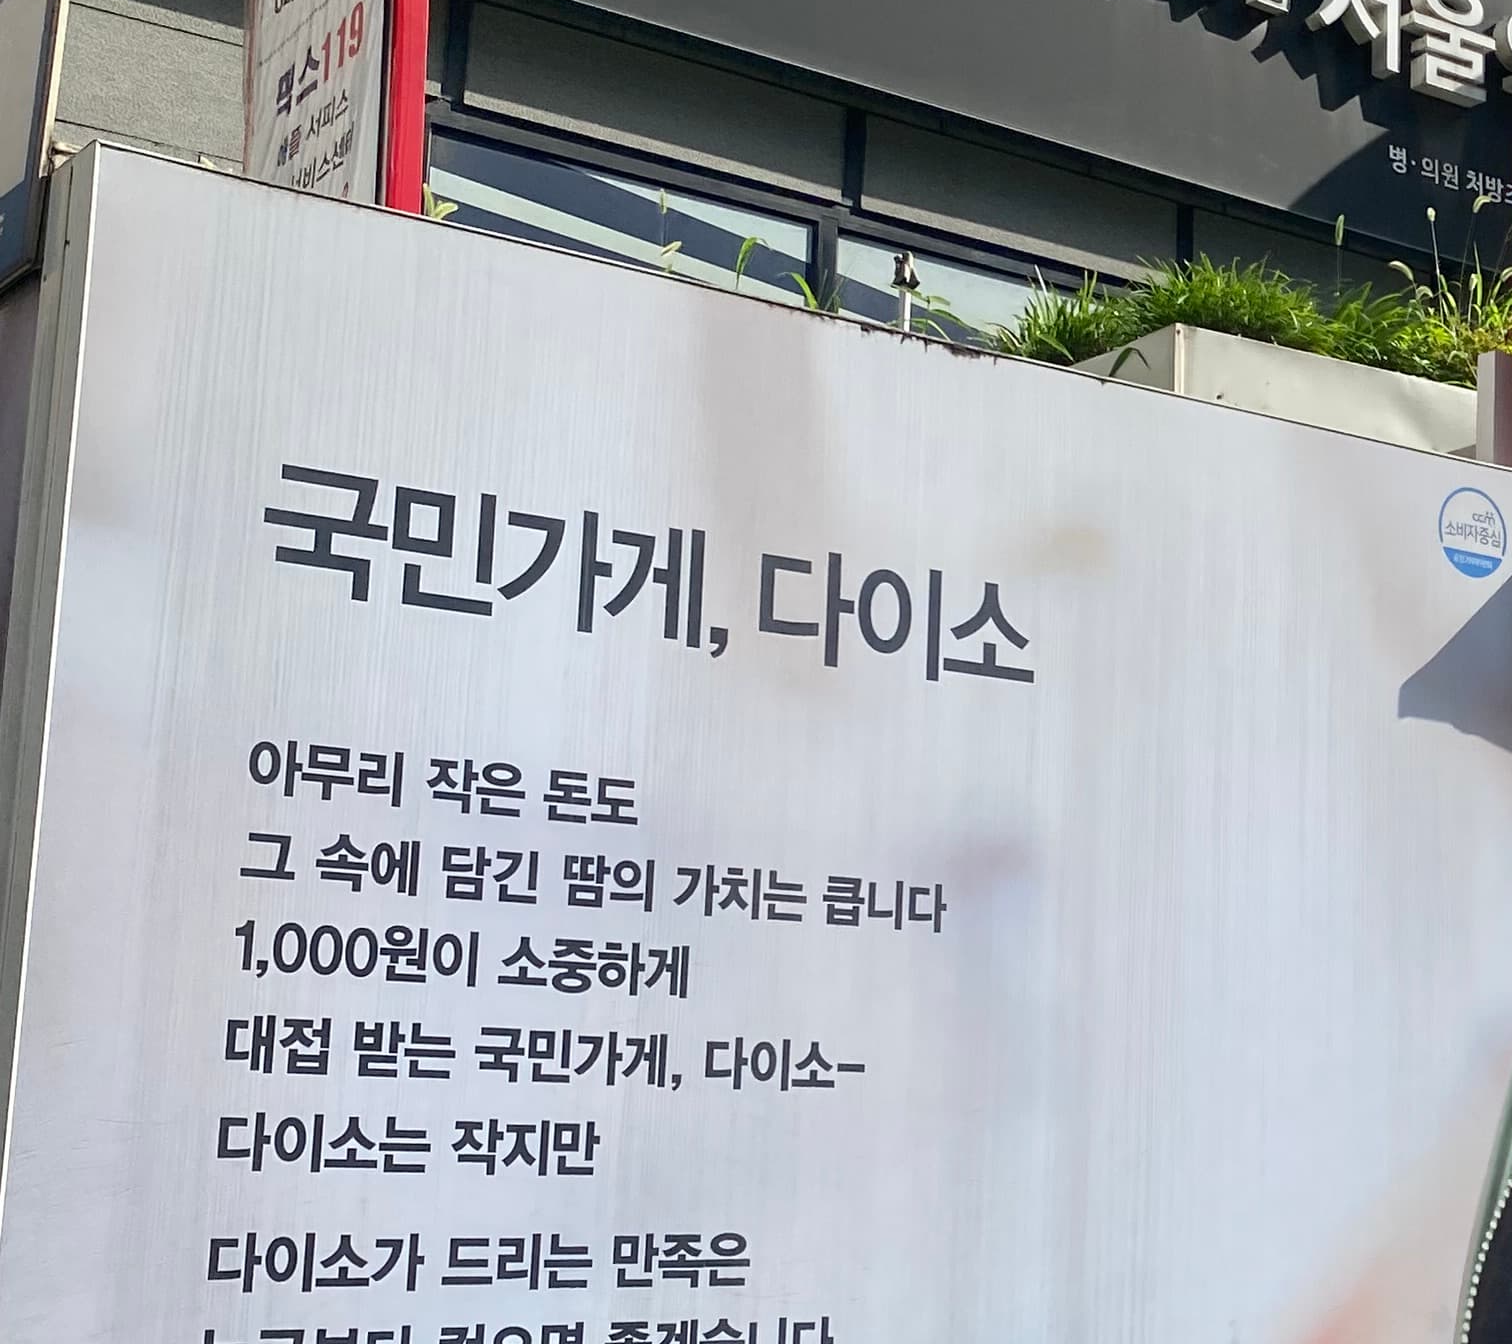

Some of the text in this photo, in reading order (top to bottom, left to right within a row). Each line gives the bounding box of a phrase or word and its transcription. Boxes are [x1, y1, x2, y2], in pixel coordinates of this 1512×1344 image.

[263, 463, 1036, 685] 국민가게, 다이소
[1444, 519, 1501, 549] 소비자중심
[247, 738, 641, 827] 아무리 작은 돈도
[239, 830, 948, 935] 그 속에 담긴 땀의 가치는 큽니다
[233, 919, 692, 999] 1,000원이 소중하게
[223, 1013, 333, 1078] 대접
[351, 1019, 457, 1081] 받는
[473, 1023, 683, 1093] 국민가게,
[215, 1111, 602, 1177] 다이소는 작지만
[206, 1230, 752, 1295] 다이소가 드리는 만족은
